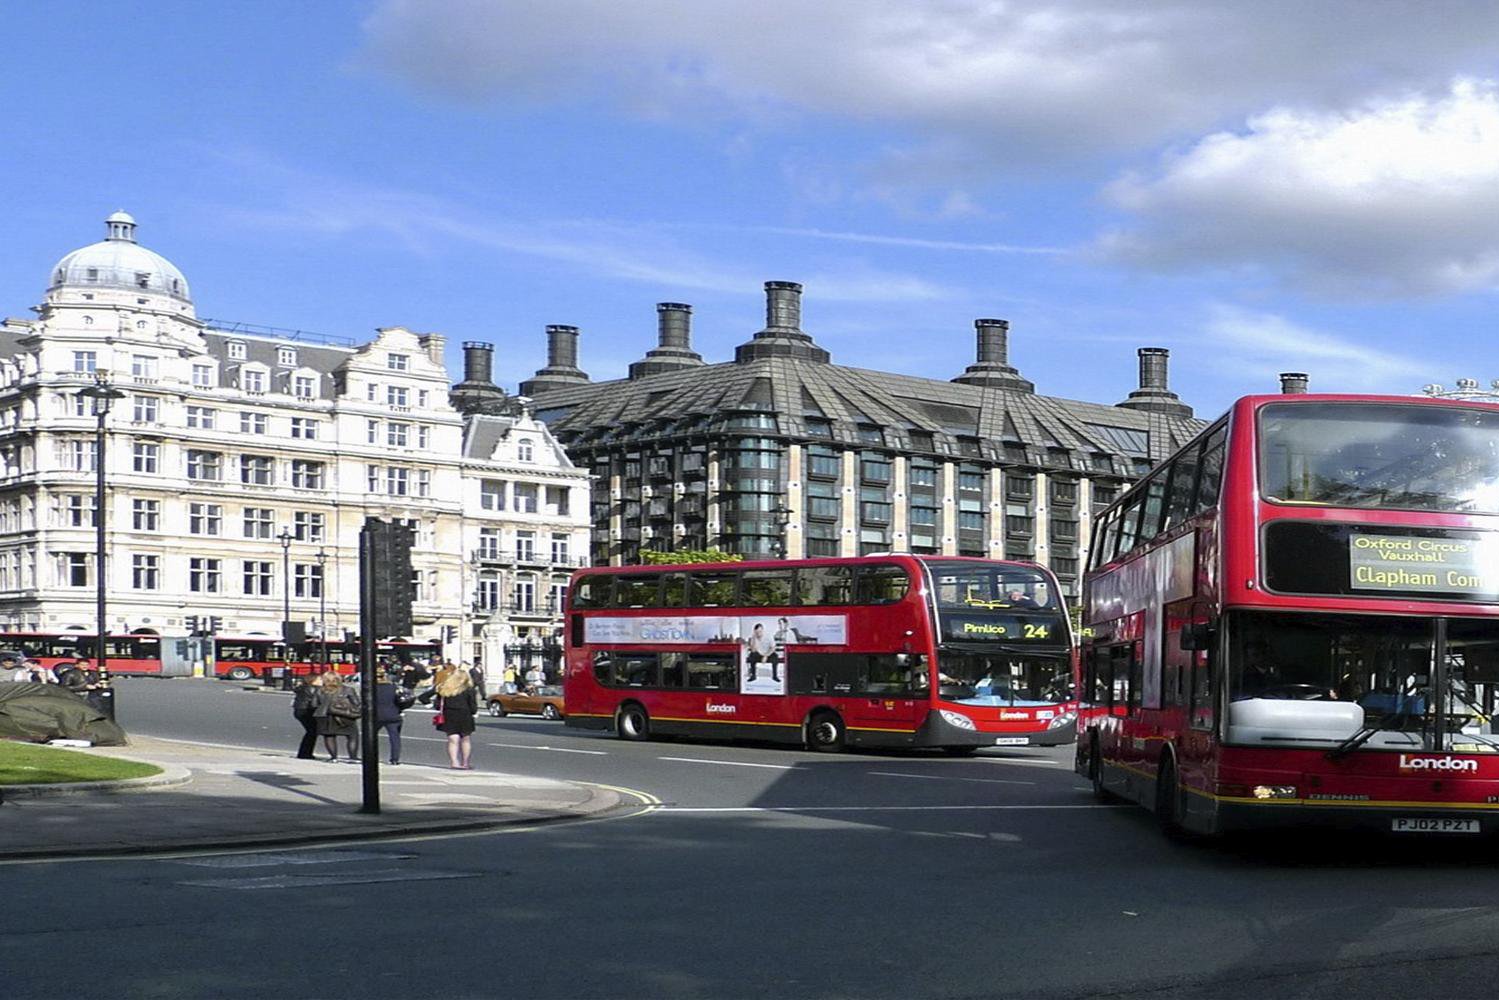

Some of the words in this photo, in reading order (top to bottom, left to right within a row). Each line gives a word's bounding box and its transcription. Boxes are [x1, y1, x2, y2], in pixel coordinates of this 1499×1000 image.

[1355, 538, 1412, 551] Oxford
[1418, 540, 1468, 553] Circus
[1377, 549, 1446, 563] Vauxhall
[1356, 567, 1437, 587] Clapham
[964, 623, 1006, 635] Pimlico
[1023, 624, 1049, 639] 24
[705, 702, 737, 713] London
[1400, 755, 1477, 771] London
[1397, 820, 1440, 831] PJ02
[1442, 820, 1474, 832] PZT
